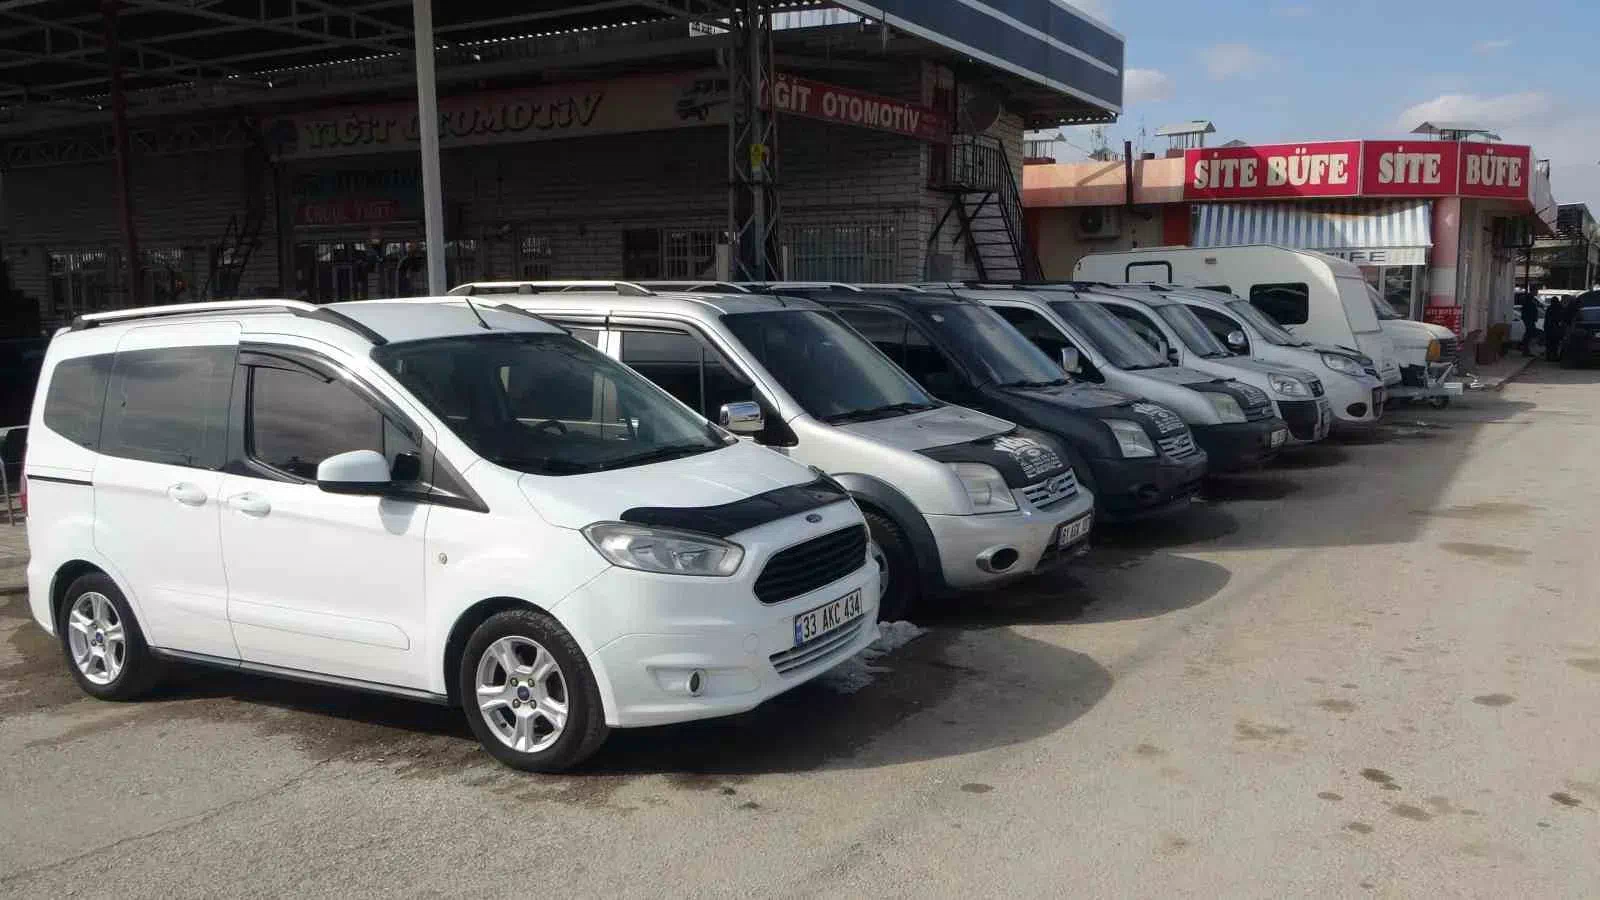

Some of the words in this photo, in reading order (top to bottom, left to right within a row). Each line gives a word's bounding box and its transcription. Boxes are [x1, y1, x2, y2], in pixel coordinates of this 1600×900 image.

[760, 72, 811, 113] ĞİT
[822, 91, 919, 132] OTOMOTİV
[1194, 152, 1257, 189] SİTE
[1267, 148, 1348, 186] BÜFE
[1378, 146, 1440, 184] SİTE
[1466, 148, 1521, 187] BÜFE
[803, 613, 817, 639] 33
[822, 602, 841, 631] AKC
[844, 591, 860, 618] 434
